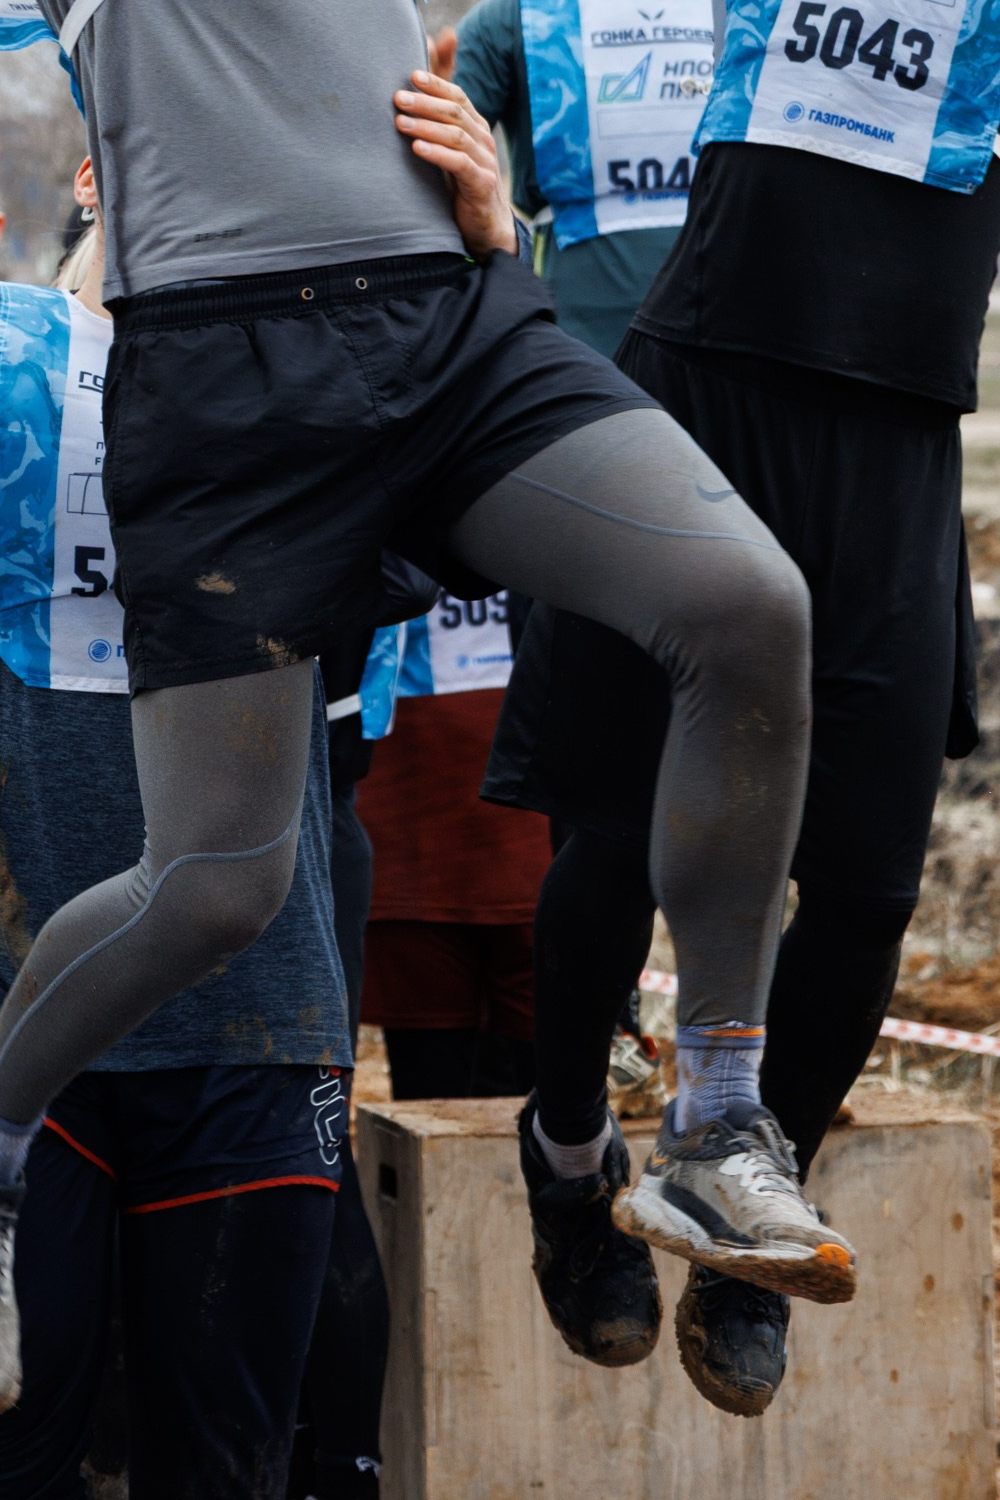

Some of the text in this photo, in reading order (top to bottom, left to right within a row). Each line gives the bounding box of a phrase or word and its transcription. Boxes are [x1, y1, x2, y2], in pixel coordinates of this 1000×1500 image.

[591, 27, 647, 43] ГОНКА
[784, 1, 935, 91] 5043
[663, 59, 712, 77] НПО
[808, 108, 896, 144] ГАЗПРОМБАНК
